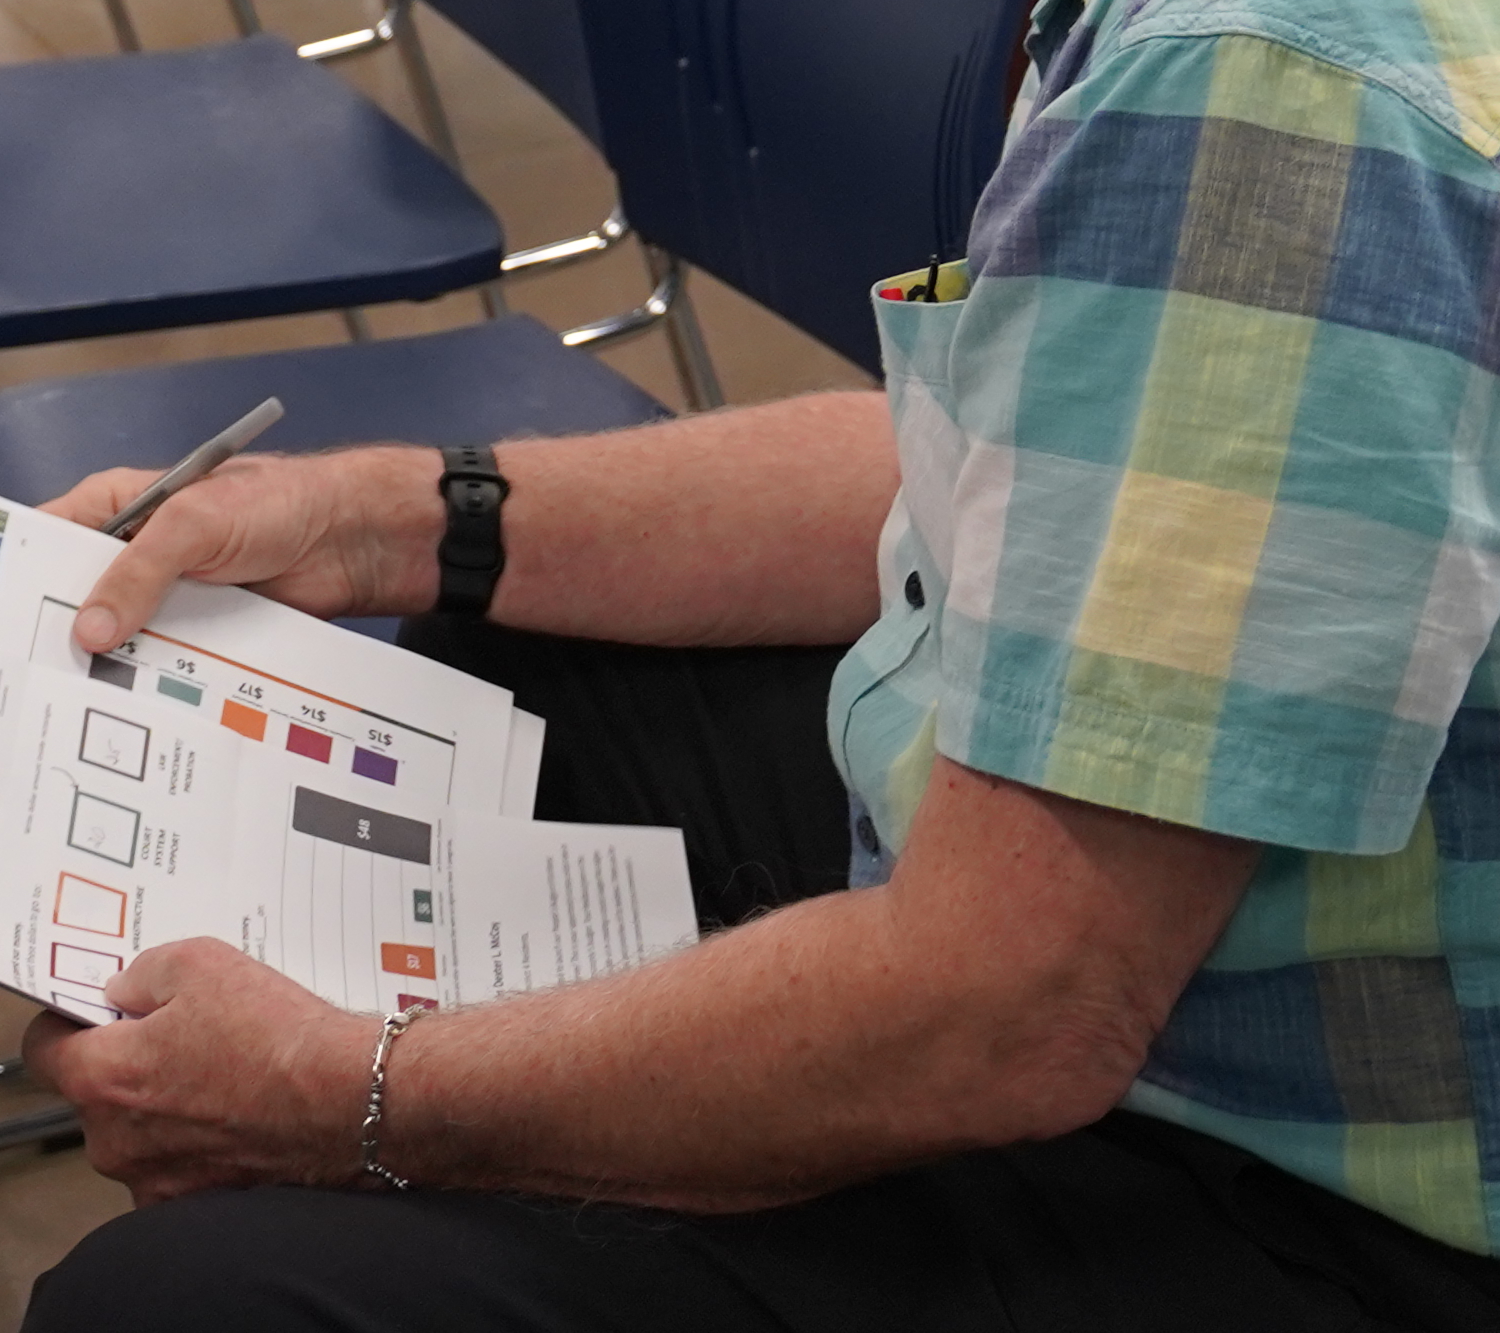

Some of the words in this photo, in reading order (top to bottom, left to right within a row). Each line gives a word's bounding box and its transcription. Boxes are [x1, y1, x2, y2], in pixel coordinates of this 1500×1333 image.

[176, 658, 195, 674] $6
[238, 682, 264, 699] $17
[301, 704, 327, 722] $14
[368, 729, 393, 746] $15
[357, 819, 371, 840] $48
[142, 826, 153, 860] COURT
[154, 829, 167, 867] SYSTEM
[167, 833, 180, 876] SUPPORT
[490, 921, 500, 949] McCoy
[493, 960, 504, 987] Dexter
